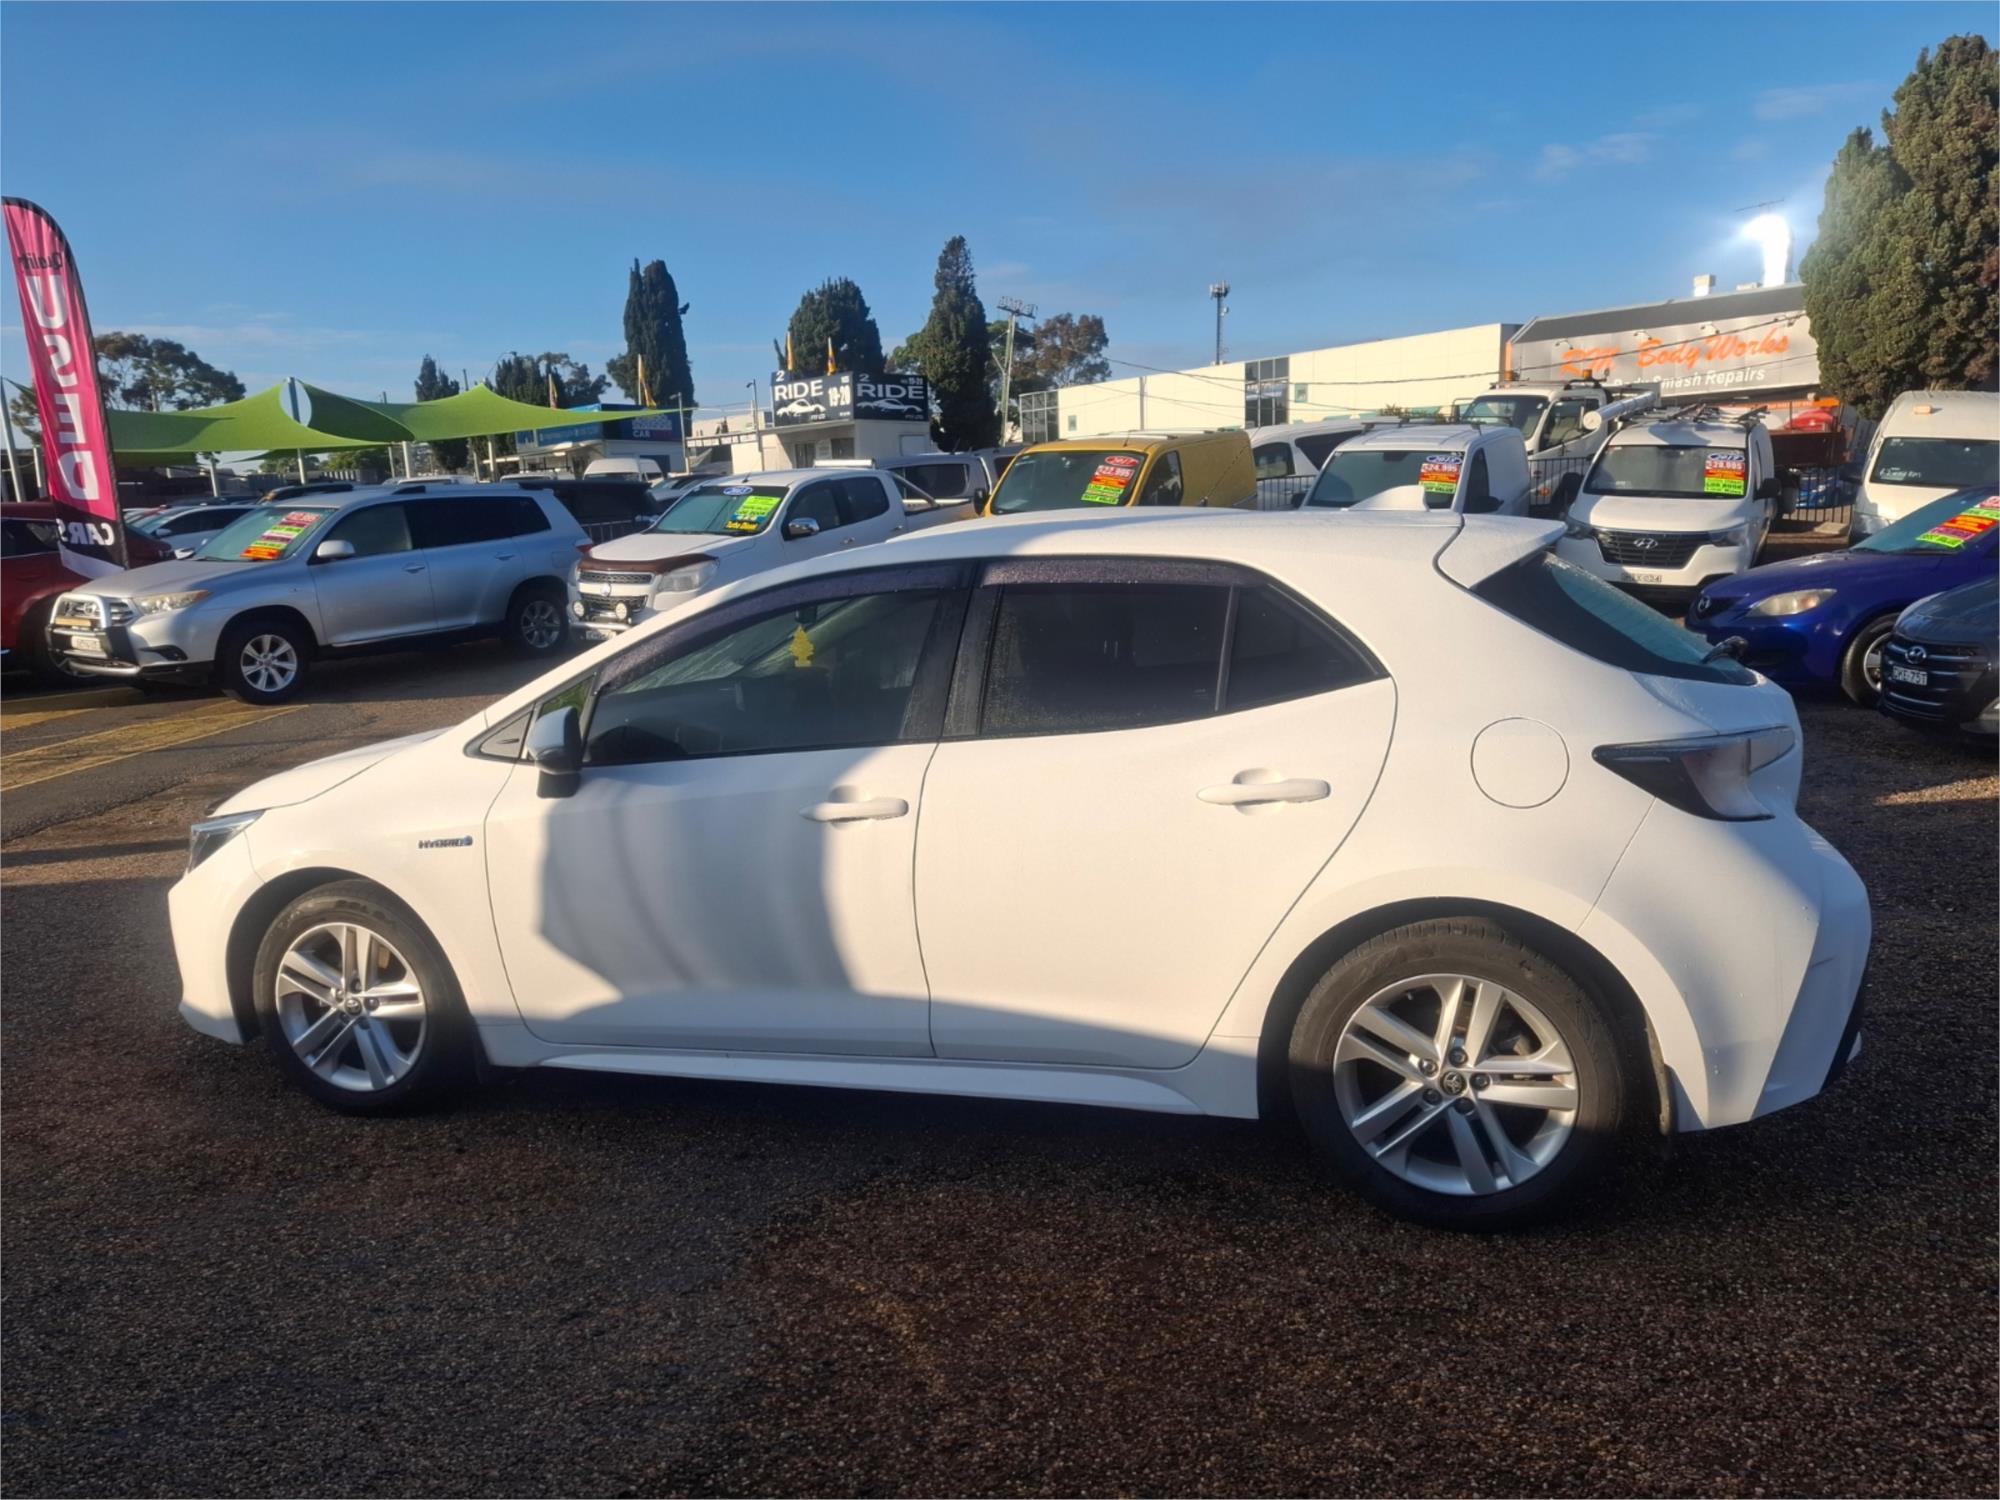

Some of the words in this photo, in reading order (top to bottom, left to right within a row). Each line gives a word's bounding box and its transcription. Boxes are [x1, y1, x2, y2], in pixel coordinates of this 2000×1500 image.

[1637, 338, 1701, 369] Body
[1704, 326, 1790, 361] Works
[776, 370, 785, 382] 2
[859, 373, 870, 382] 2
[1704, 367, 1766, 387] Repairs
[774, 379, 824, 402] RIDE
[857, 383, 924, 399] RIDE
[633, 430, 650, 438] CAR
